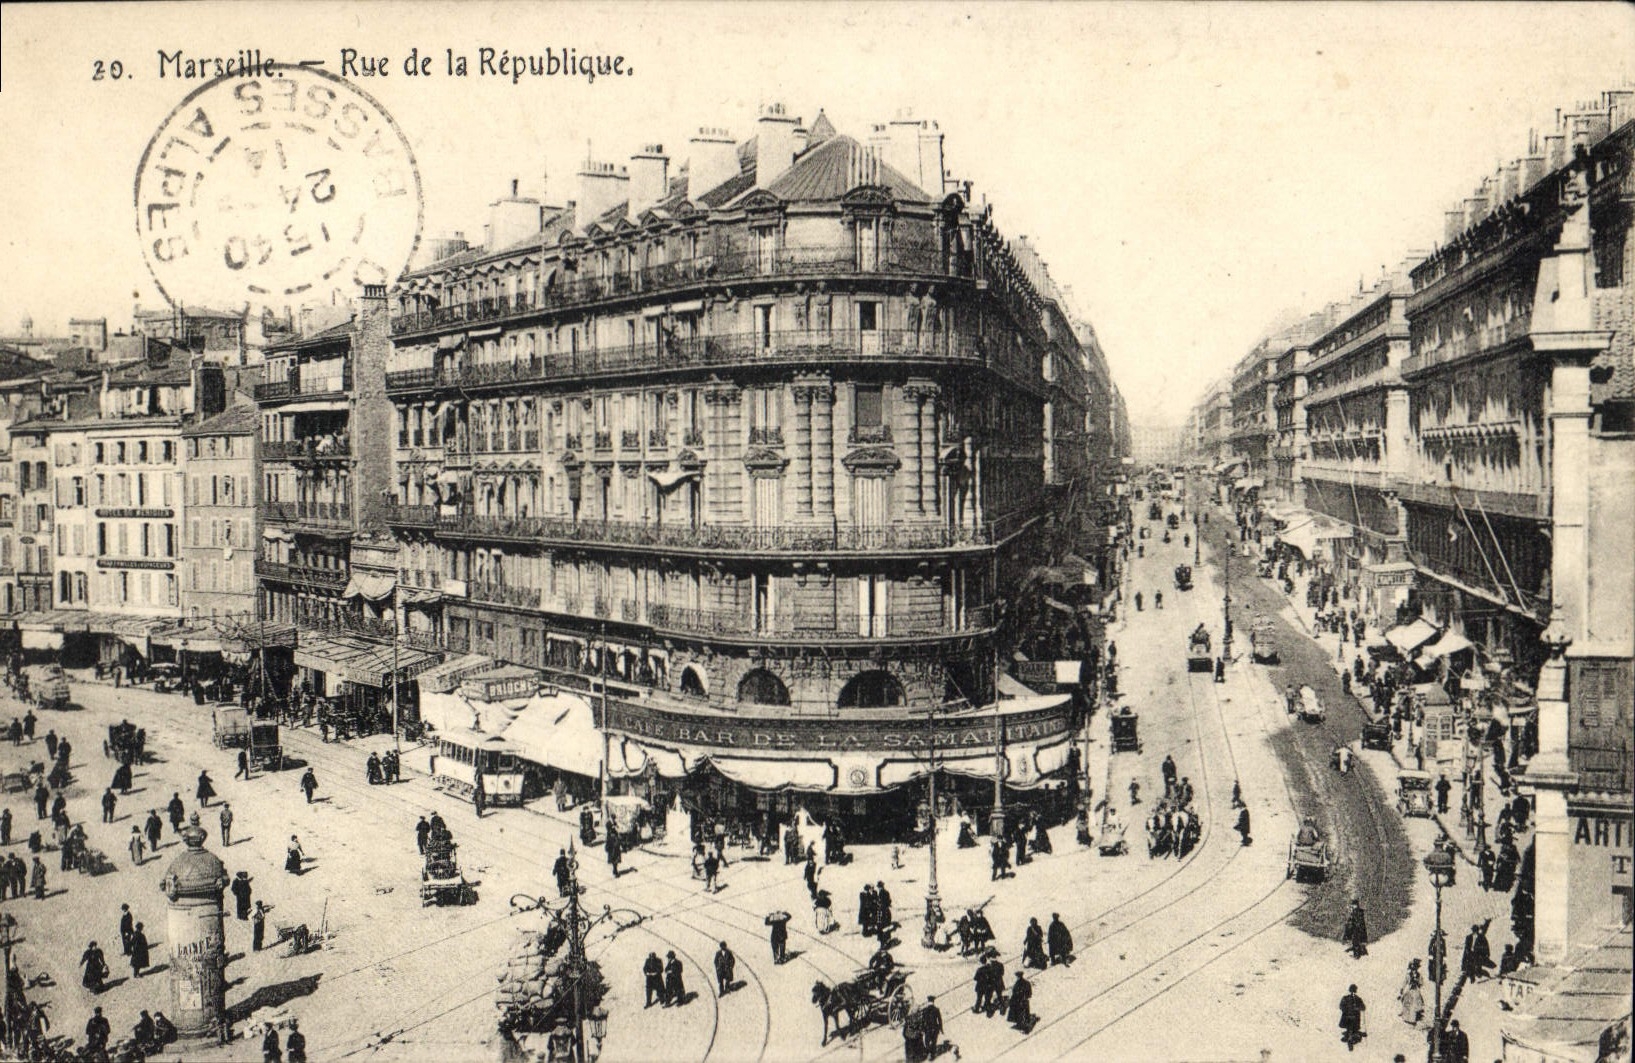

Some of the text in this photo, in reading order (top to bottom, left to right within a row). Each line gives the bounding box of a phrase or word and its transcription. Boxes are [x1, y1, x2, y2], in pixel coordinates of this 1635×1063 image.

[678, 727, 735, 745] BAR
[753, 733, 796, 747] DE
[818, 734, 865, 747] LA
